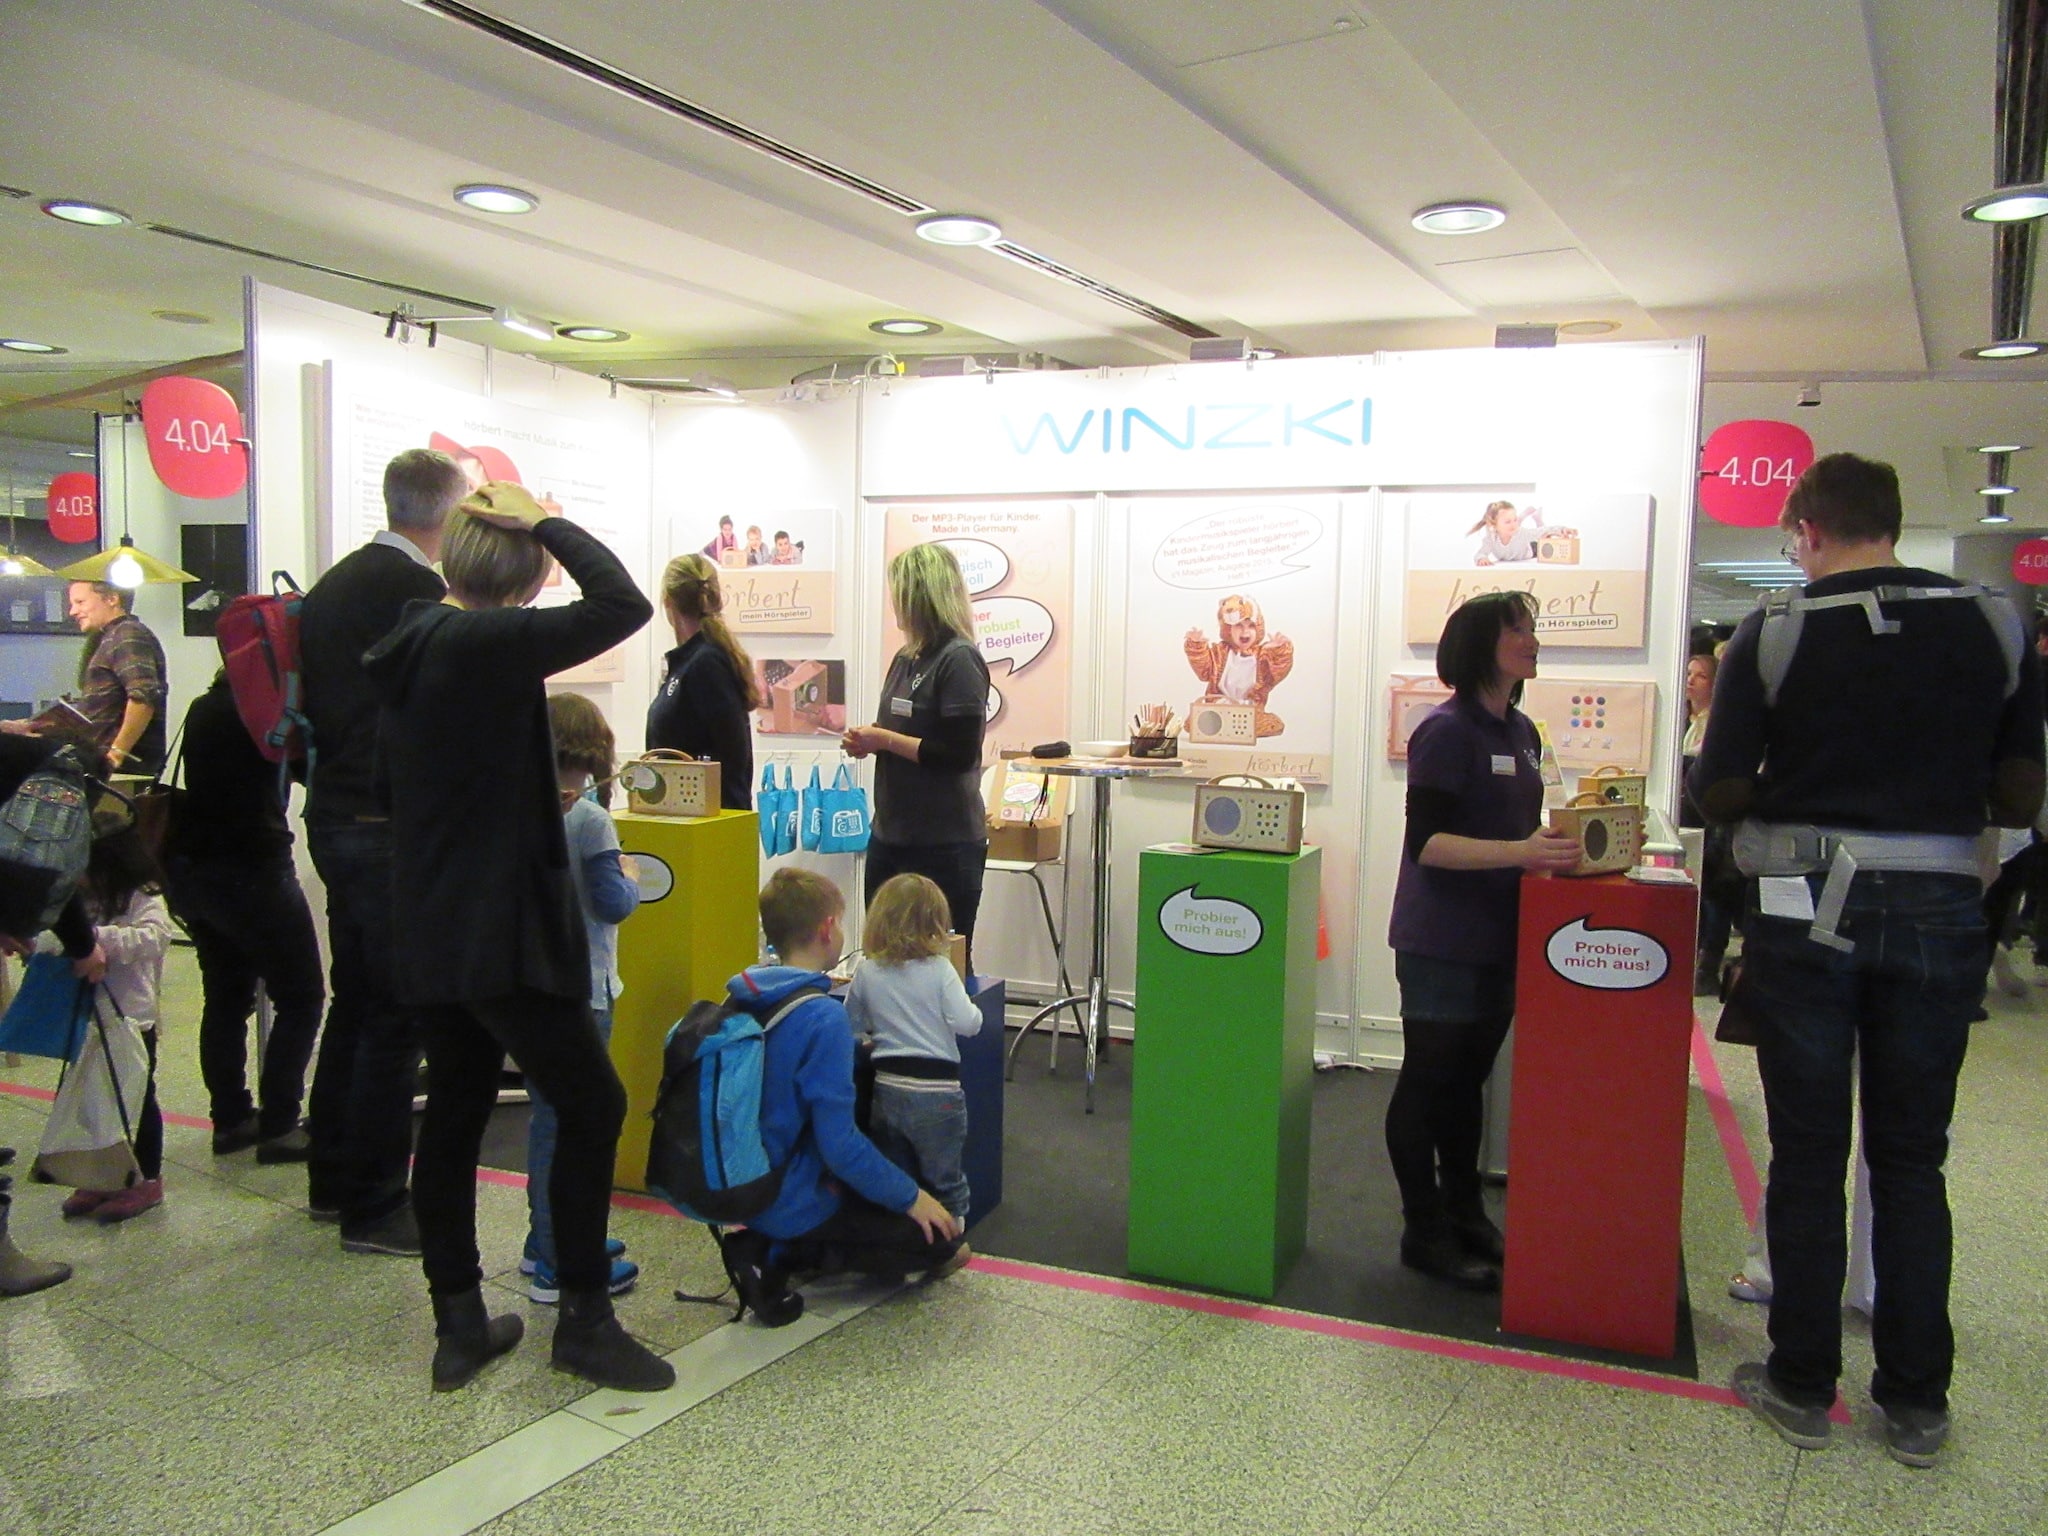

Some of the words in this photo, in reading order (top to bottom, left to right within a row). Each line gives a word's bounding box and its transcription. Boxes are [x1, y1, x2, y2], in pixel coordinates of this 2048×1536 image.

[1000, 397, 1372, 454] WINZKI
[165, 418, 231, 454] 4.04
[1719, 457, 1796, 487] 4.04
[56, 496, 94, 516] 4.03
[912, 514, 928, 523] Der
[932, 513, 986, 524] MP3-Player
[990, 512, 1003, 522] für
[1007, 511, 1041, 522] Kinder.
[932, 525, 958, 533] Made
[962, 524, 970, 532] in
[721, 578, 802, 608] örbert
[764, 610, 809, 621] Hörspieler
[1548, 618, 1614, 629] Hörspieler
[978, 618, 1021, 634] robust
[985, 631, 1045, 649] Begleiter
[1184, 908, 1239, 925] Probier
[1174, 922, 1211, 936] mich
[1215, 928, 1247, 939] aus!
[1575, 941, 1641, 957] Probier
[1564, 956, 1607, 969] mich
[1613, 959, 1650, 972] aus!
